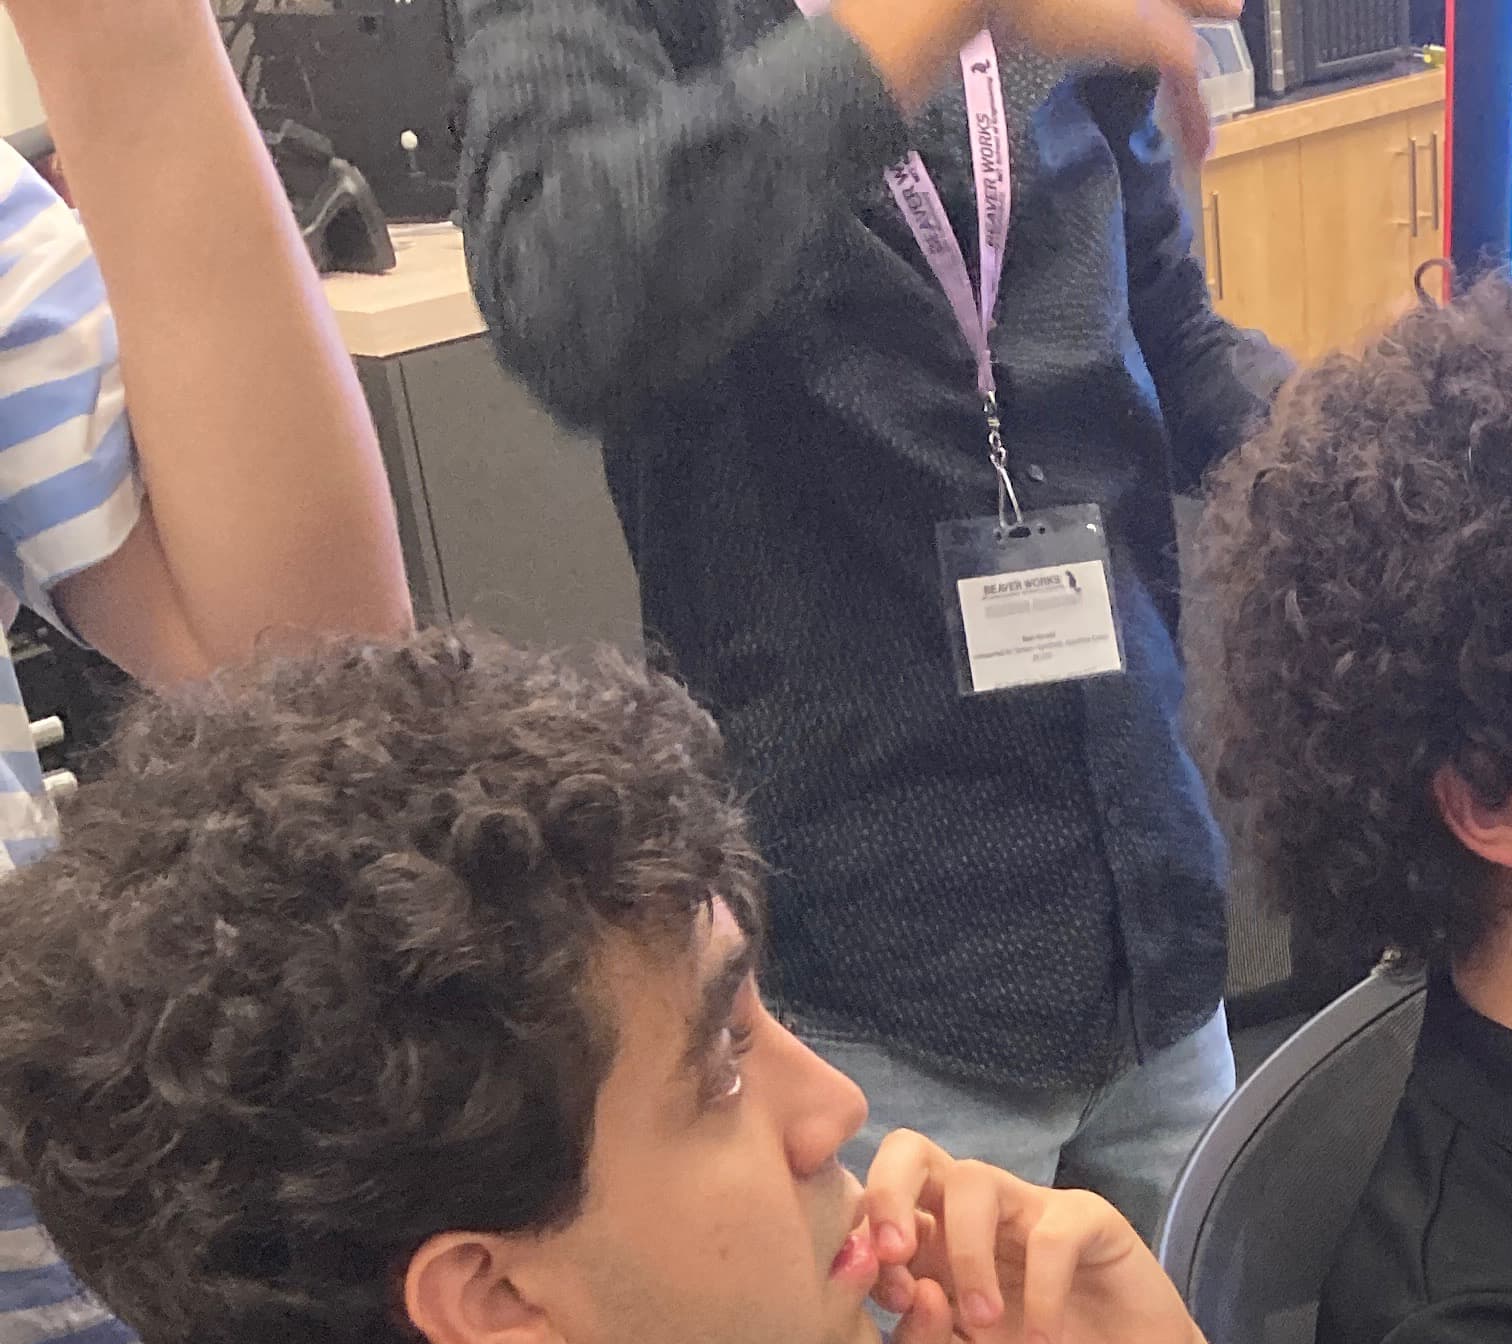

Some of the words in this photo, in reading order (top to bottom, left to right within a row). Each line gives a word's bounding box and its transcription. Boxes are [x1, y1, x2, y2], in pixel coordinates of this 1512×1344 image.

[976, 112, 994, 174] WORKS
[984, 580, 1022, 595] BEAVER
[1023, 575, 1062, 589] WORKS
